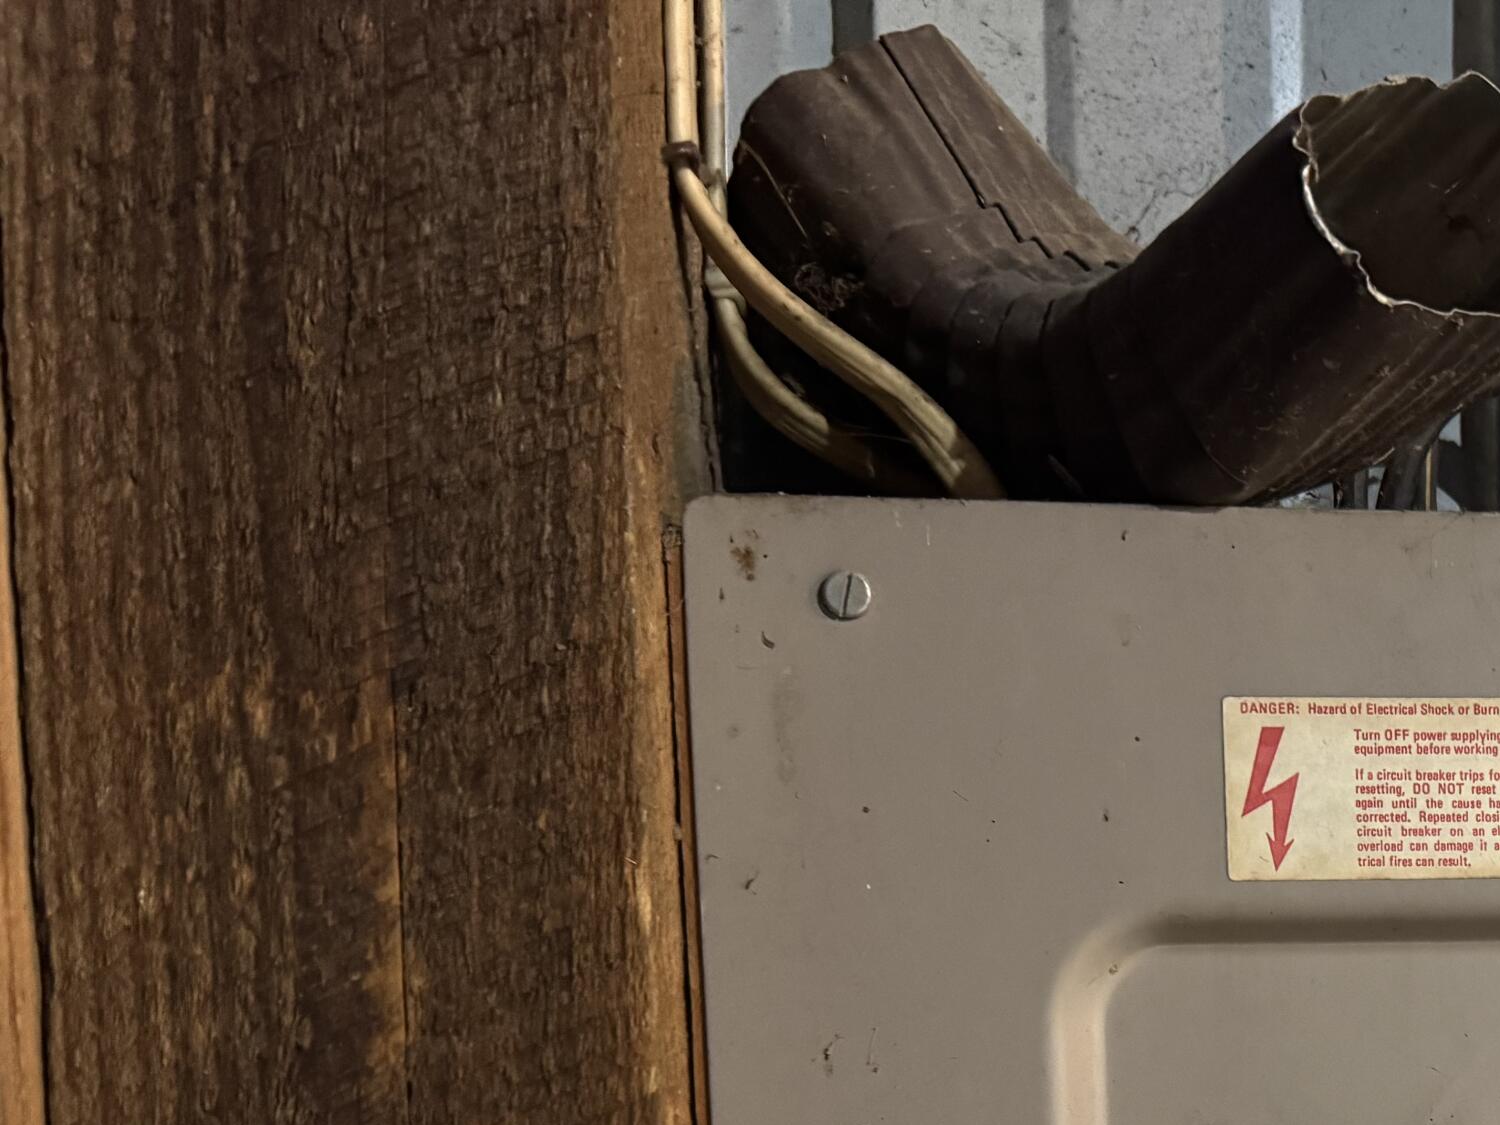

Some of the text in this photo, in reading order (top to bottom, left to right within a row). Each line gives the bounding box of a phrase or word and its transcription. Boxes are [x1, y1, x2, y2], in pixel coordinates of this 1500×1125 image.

[1240, 702, 1500, 716] DANGER: Hazard of Electrical Shock or Burn
[1353, 728, 1381, 744] Turn
[1384, 728, 1410, 742] OFF
[1413, 732, 1448, 744] power
[1354, 742, 1412, 757] equipment
[1416, 742, 1451, 755] before
[1453, 742, 1499, 756] working
[1355, 768, 1364, 781] If
[1367, 771, 1374, 781] a
[1376, 768, 1412, 782] circuit
[1415, 769, 1457, 782] breaker
[1459, 769, 1485, 783] trips
[1355, 782, 1406, 797] resetting,
[1412, 782, 1431, 796] DO
[1438, 782, 1465, 795] NOT
[1471, 782, 1497, 796] reset
[1355, 796, 1384, 811] again
[1391, 796, 1417, 810] until
[1425, 797, 1444, 810] the
[1451, 799, 1482, 810] cause
[1356, 810, 1412, 824] corrected.
[1418, 810, 1469, 825] Repeated
[1356, 825, 1392, 838] circuit
[1400, 825, 1443, 837] breaker
[1449, 828, 1464, 837] on
[1472, 828, 1486, 837] an
[1357, 839, 1404, 852] overload
[1409, 842, 1429, 852] can
[1433, 839, 1474, 854] damage
[1479, 838, 1488, 852] it
[1357, 855, 1472, 868] trical fires can result.
